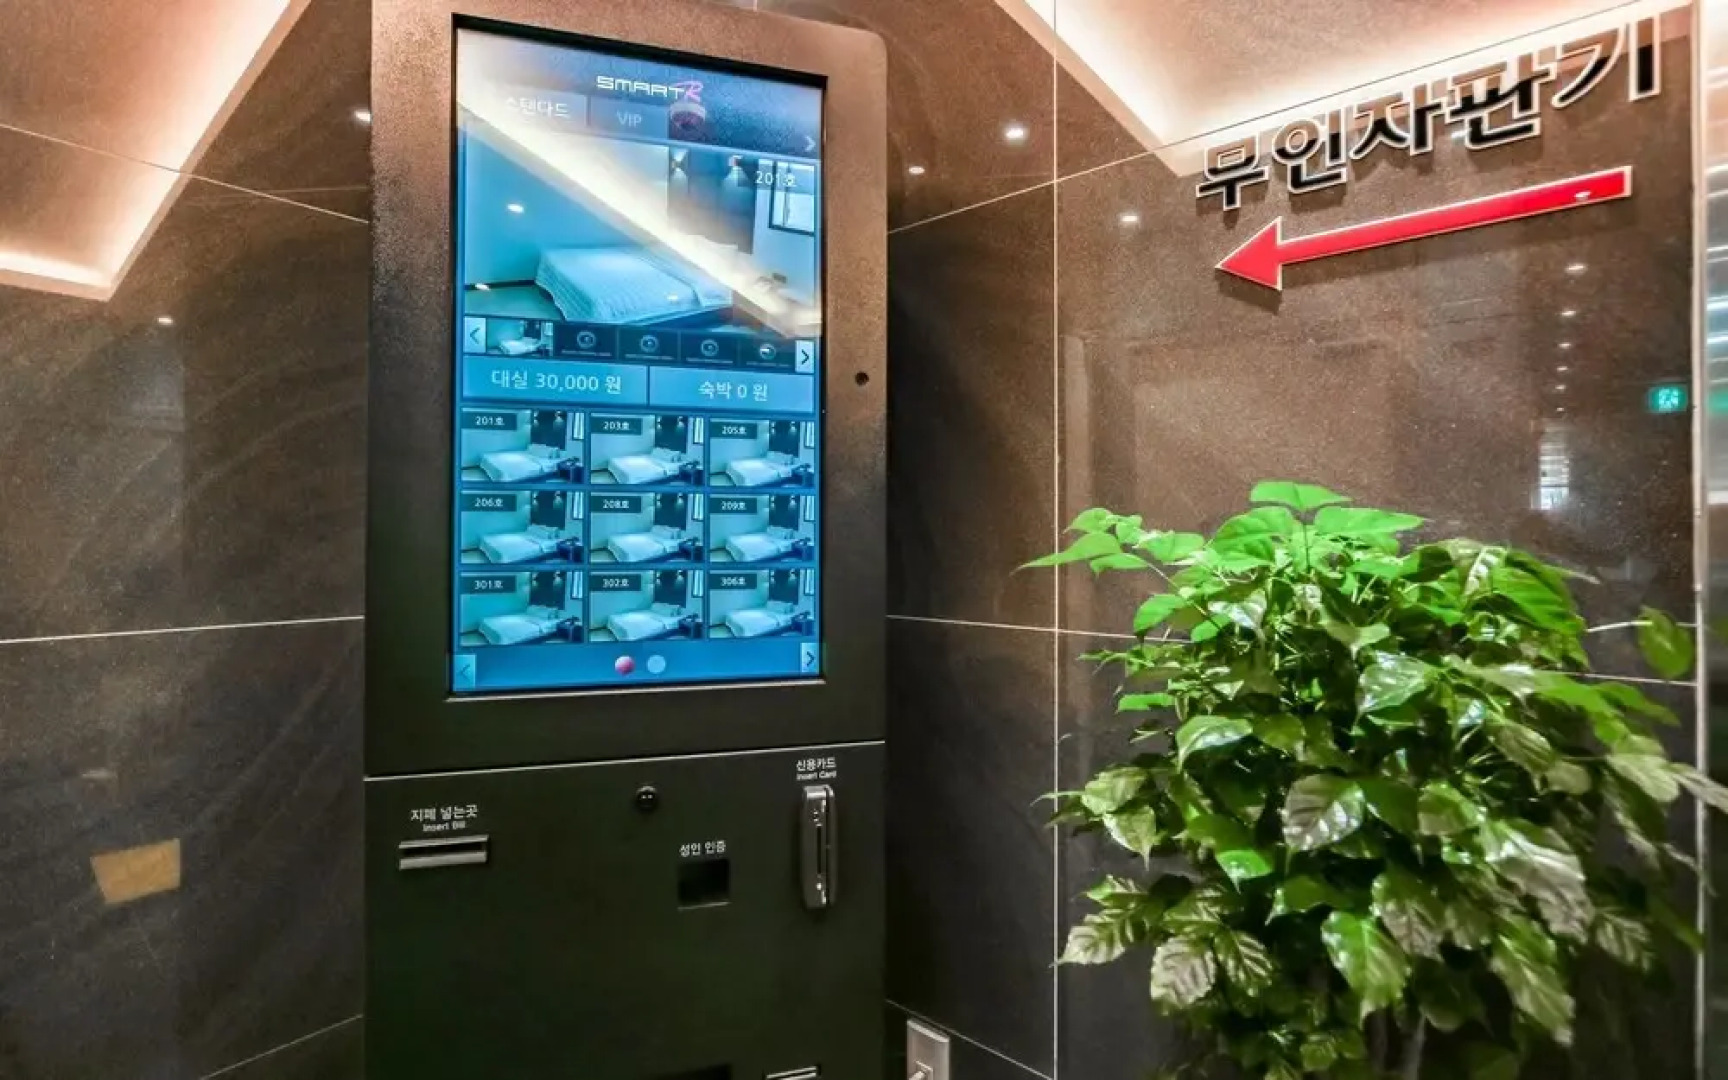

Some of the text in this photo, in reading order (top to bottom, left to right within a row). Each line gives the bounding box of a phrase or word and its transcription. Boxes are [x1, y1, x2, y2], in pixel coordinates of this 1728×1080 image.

[1195, 12, 1662, 211] 무인자판기
[616, 111, 642, 128] VIP
[491, 369, 622, 395] 대실 30,000 원
[698, 380, 768, 402] 숙박 0 원
[475, 415, 505, 426] 201호
[602, 421, 630, 432] 203호
[721, 425, 747, 435] 205호
[474, 497, 504, 508] 206호
[473, 579, 504, 590] 301호
[796, 757, 837, 772] 신용카드
[680, 842, 701, 857] 성인
